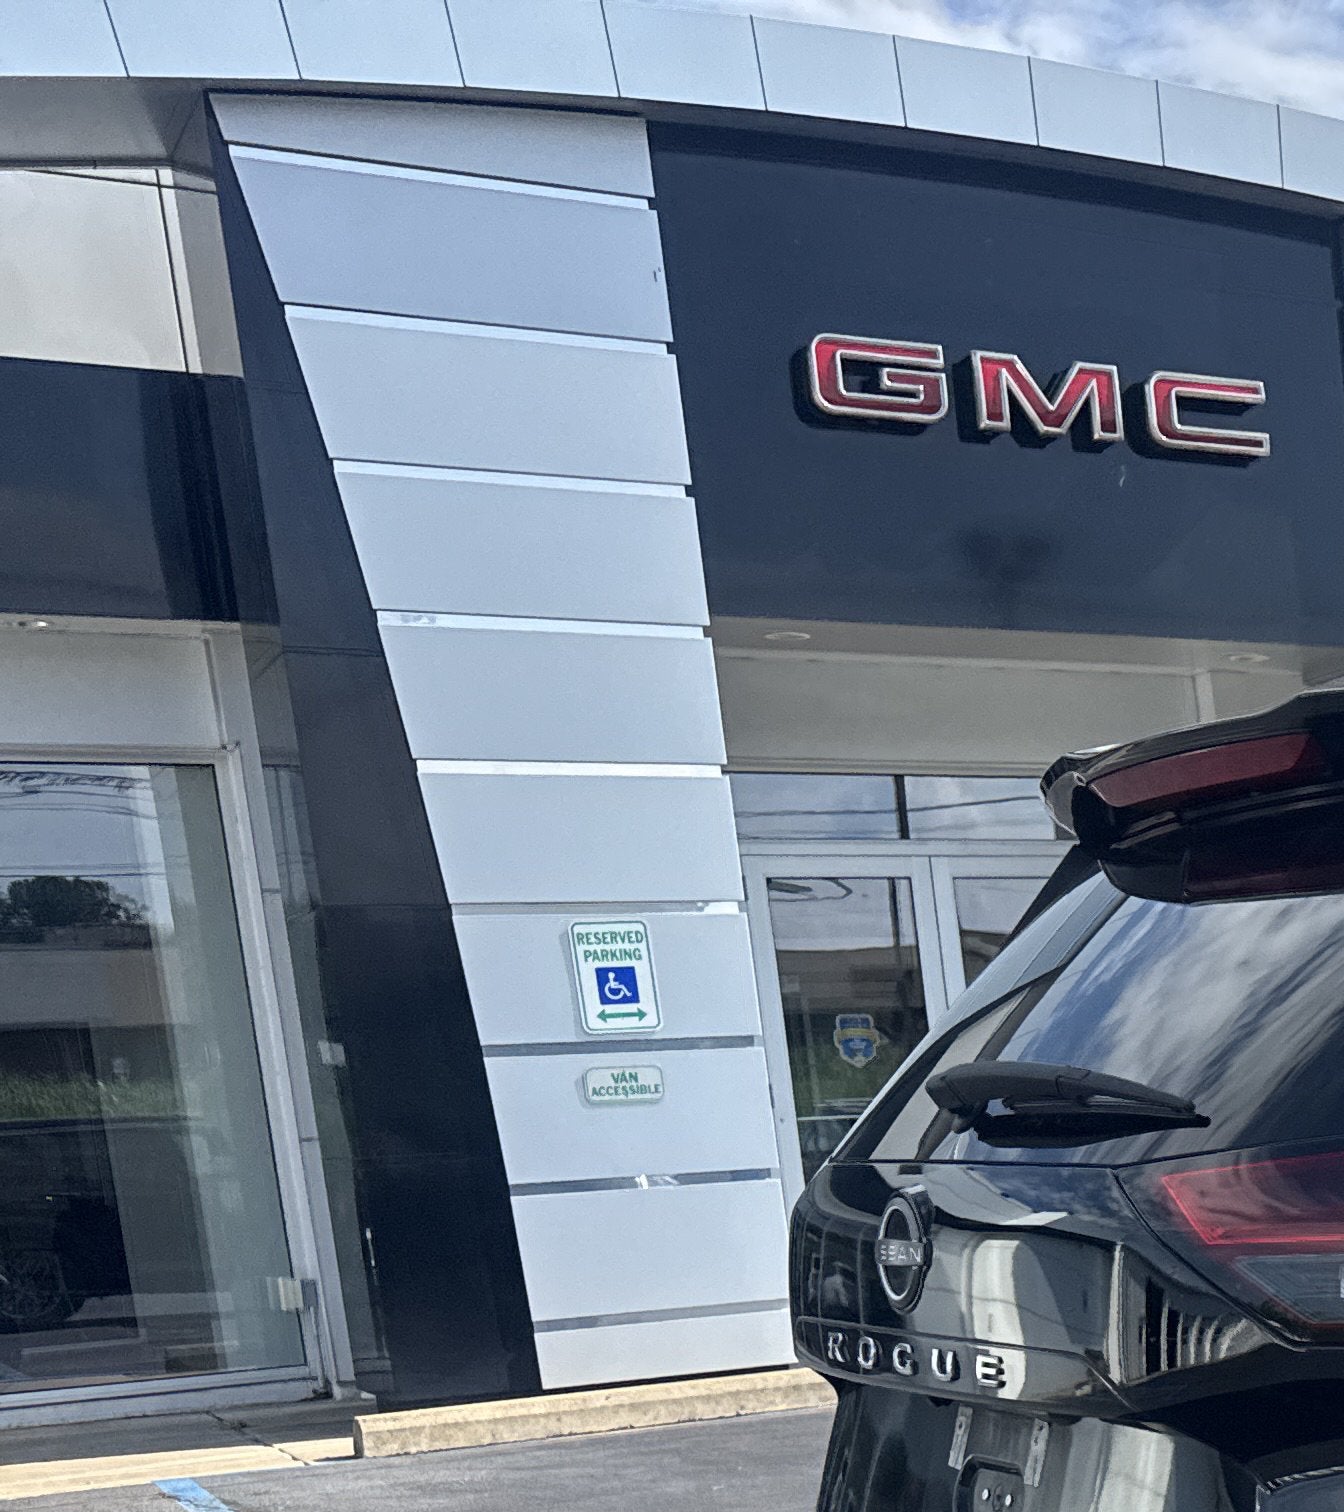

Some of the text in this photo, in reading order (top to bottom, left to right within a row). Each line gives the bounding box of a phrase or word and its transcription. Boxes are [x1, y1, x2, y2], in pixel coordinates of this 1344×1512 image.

[809, 332, 1271, 457] GMC
[575, 930, 645, 946] RESERVED
[583, 948, 643, 963] PARKING
[611, 1071, 639, 1084] VAN
[591, 1083, 662, 1098] ACCESSIBLE
[827, 1331, 1006, 1388] ROGUE
